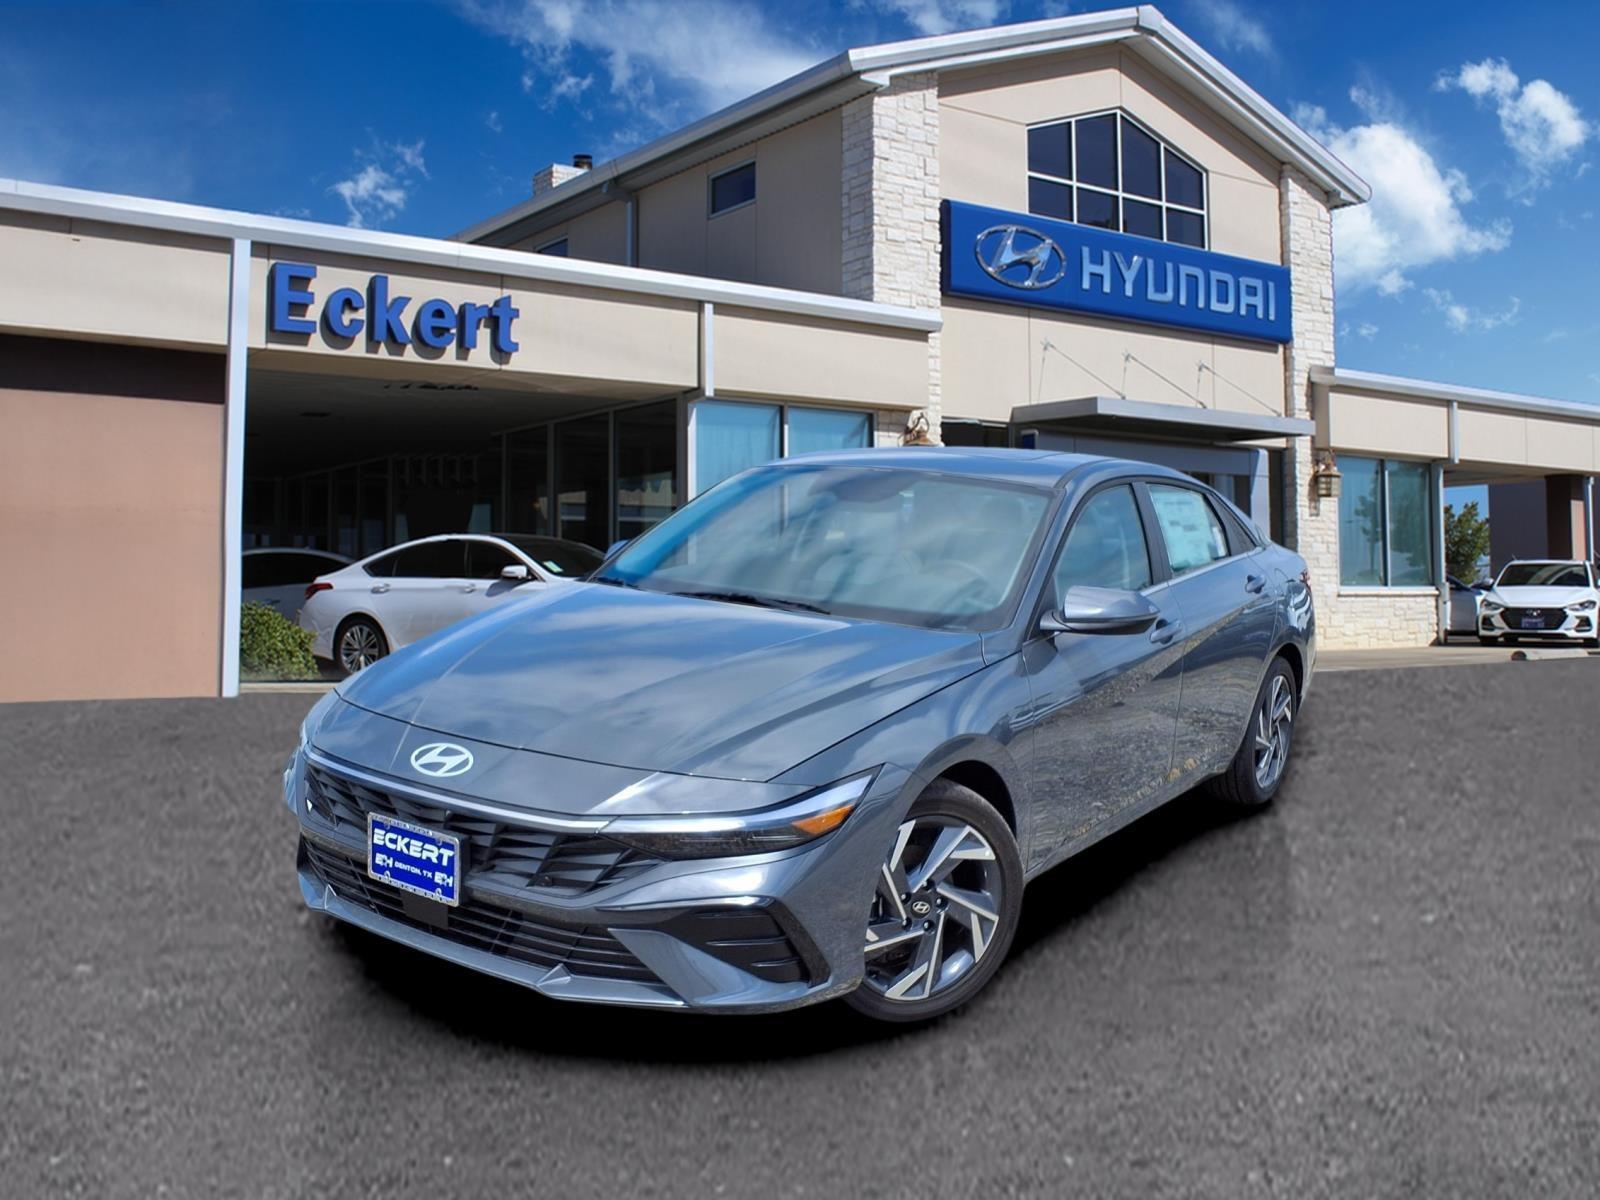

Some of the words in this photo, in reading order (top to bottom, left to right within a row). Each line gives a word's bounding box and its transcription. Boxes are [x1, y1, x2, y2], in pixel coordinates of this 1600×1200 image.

[269, 262, 520, 354] Eckert
[1081, 246, 1276, 321] HYUNDAI
[373, 828, 454, 866] ECKERT
[423, 870, 432, 879] TX
